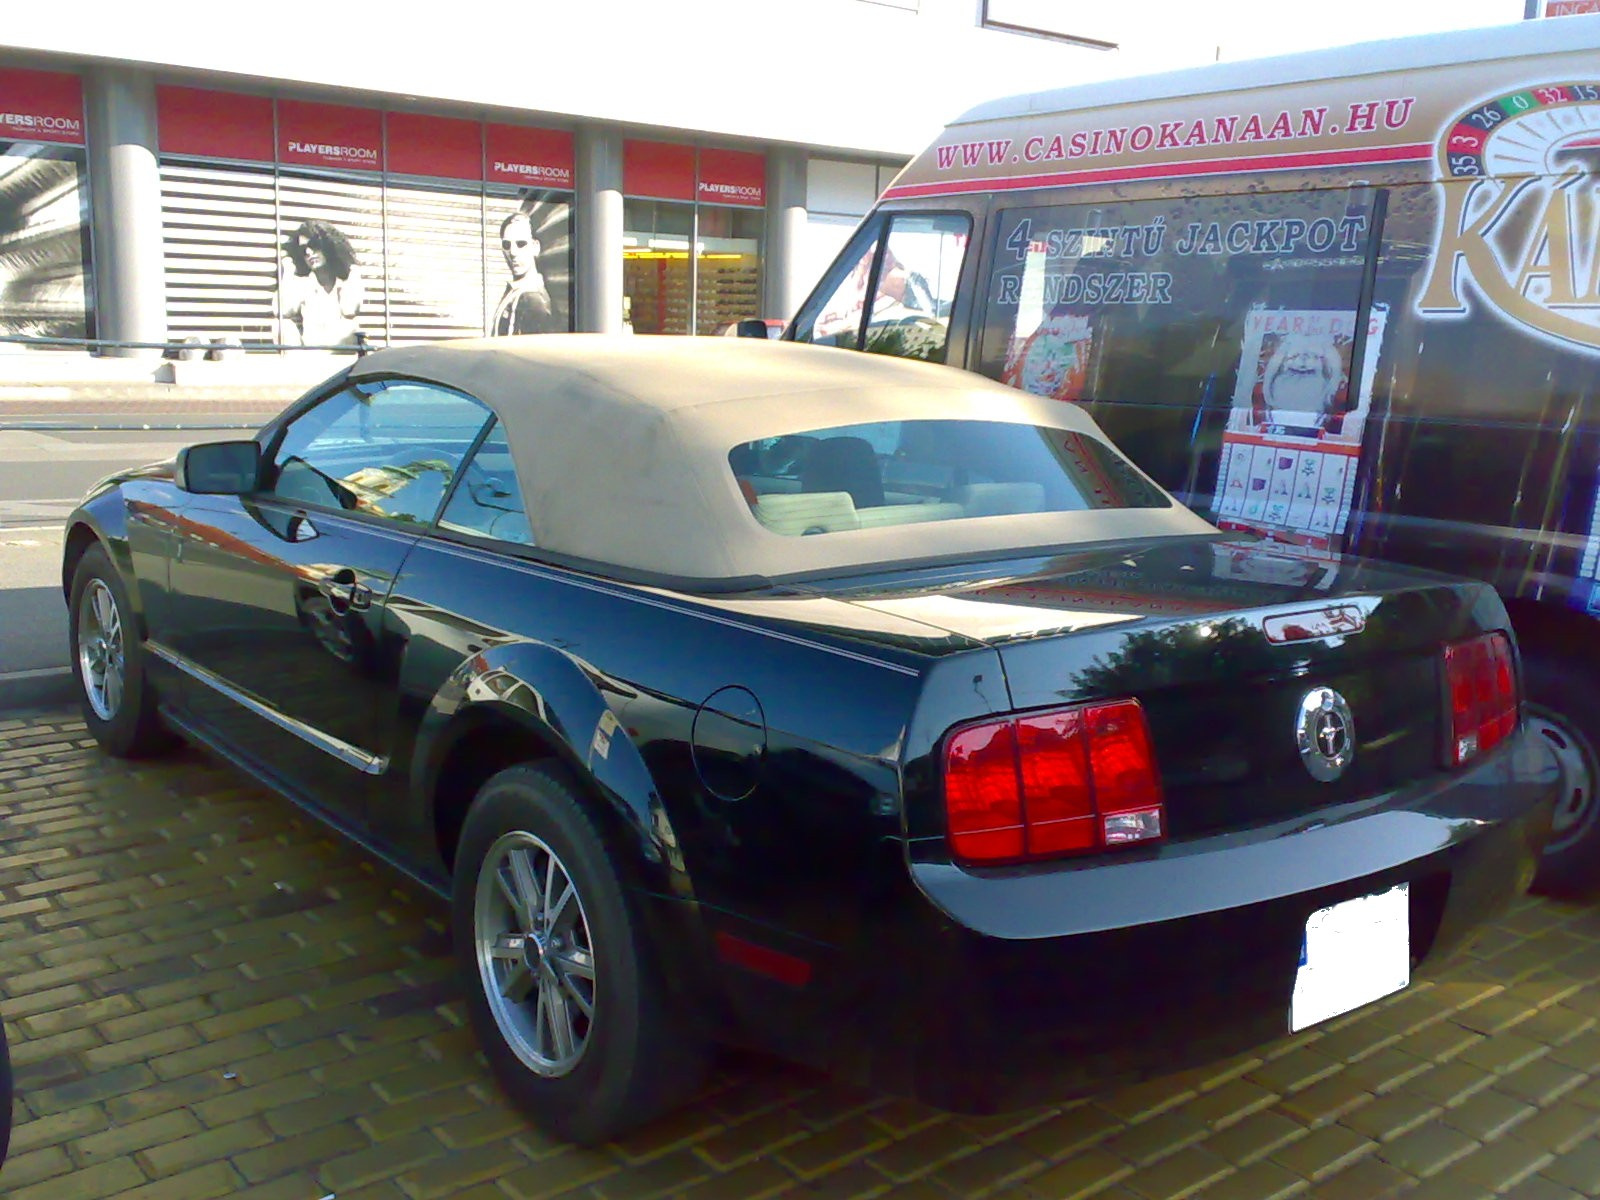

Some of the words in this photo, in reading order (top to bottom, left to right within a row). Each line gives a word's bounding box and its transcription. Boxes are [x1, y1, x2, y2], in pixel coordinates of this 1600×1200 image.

[1512, 95, 1530, 110] 0
[1539, 87, 1567, 105] 32
[1576, 85, 1599, 101] 15
[1472, 106, 1501, 129] 26
[936, 97, 1415, 170] WWW.CASINOKANAAN.HU
[1452, 136, 1479, 148] 3
[288, 141, 377, 160] PLAYERSROOM
[494, 161, 569, 178] PLAYERSROOM
[1453, 154, 1479, 176] 35
[698, 182, 761, 196] PLAYERSROOM
[1176, 215, 1367, 256] JACKPOT
[1415, 166, 1600, 316] KA
[997, 272, 1173, 304] RNDSZER
[1253, 315, 1306, 332] YEAR
[1329, 317, 1379, 336] DG
